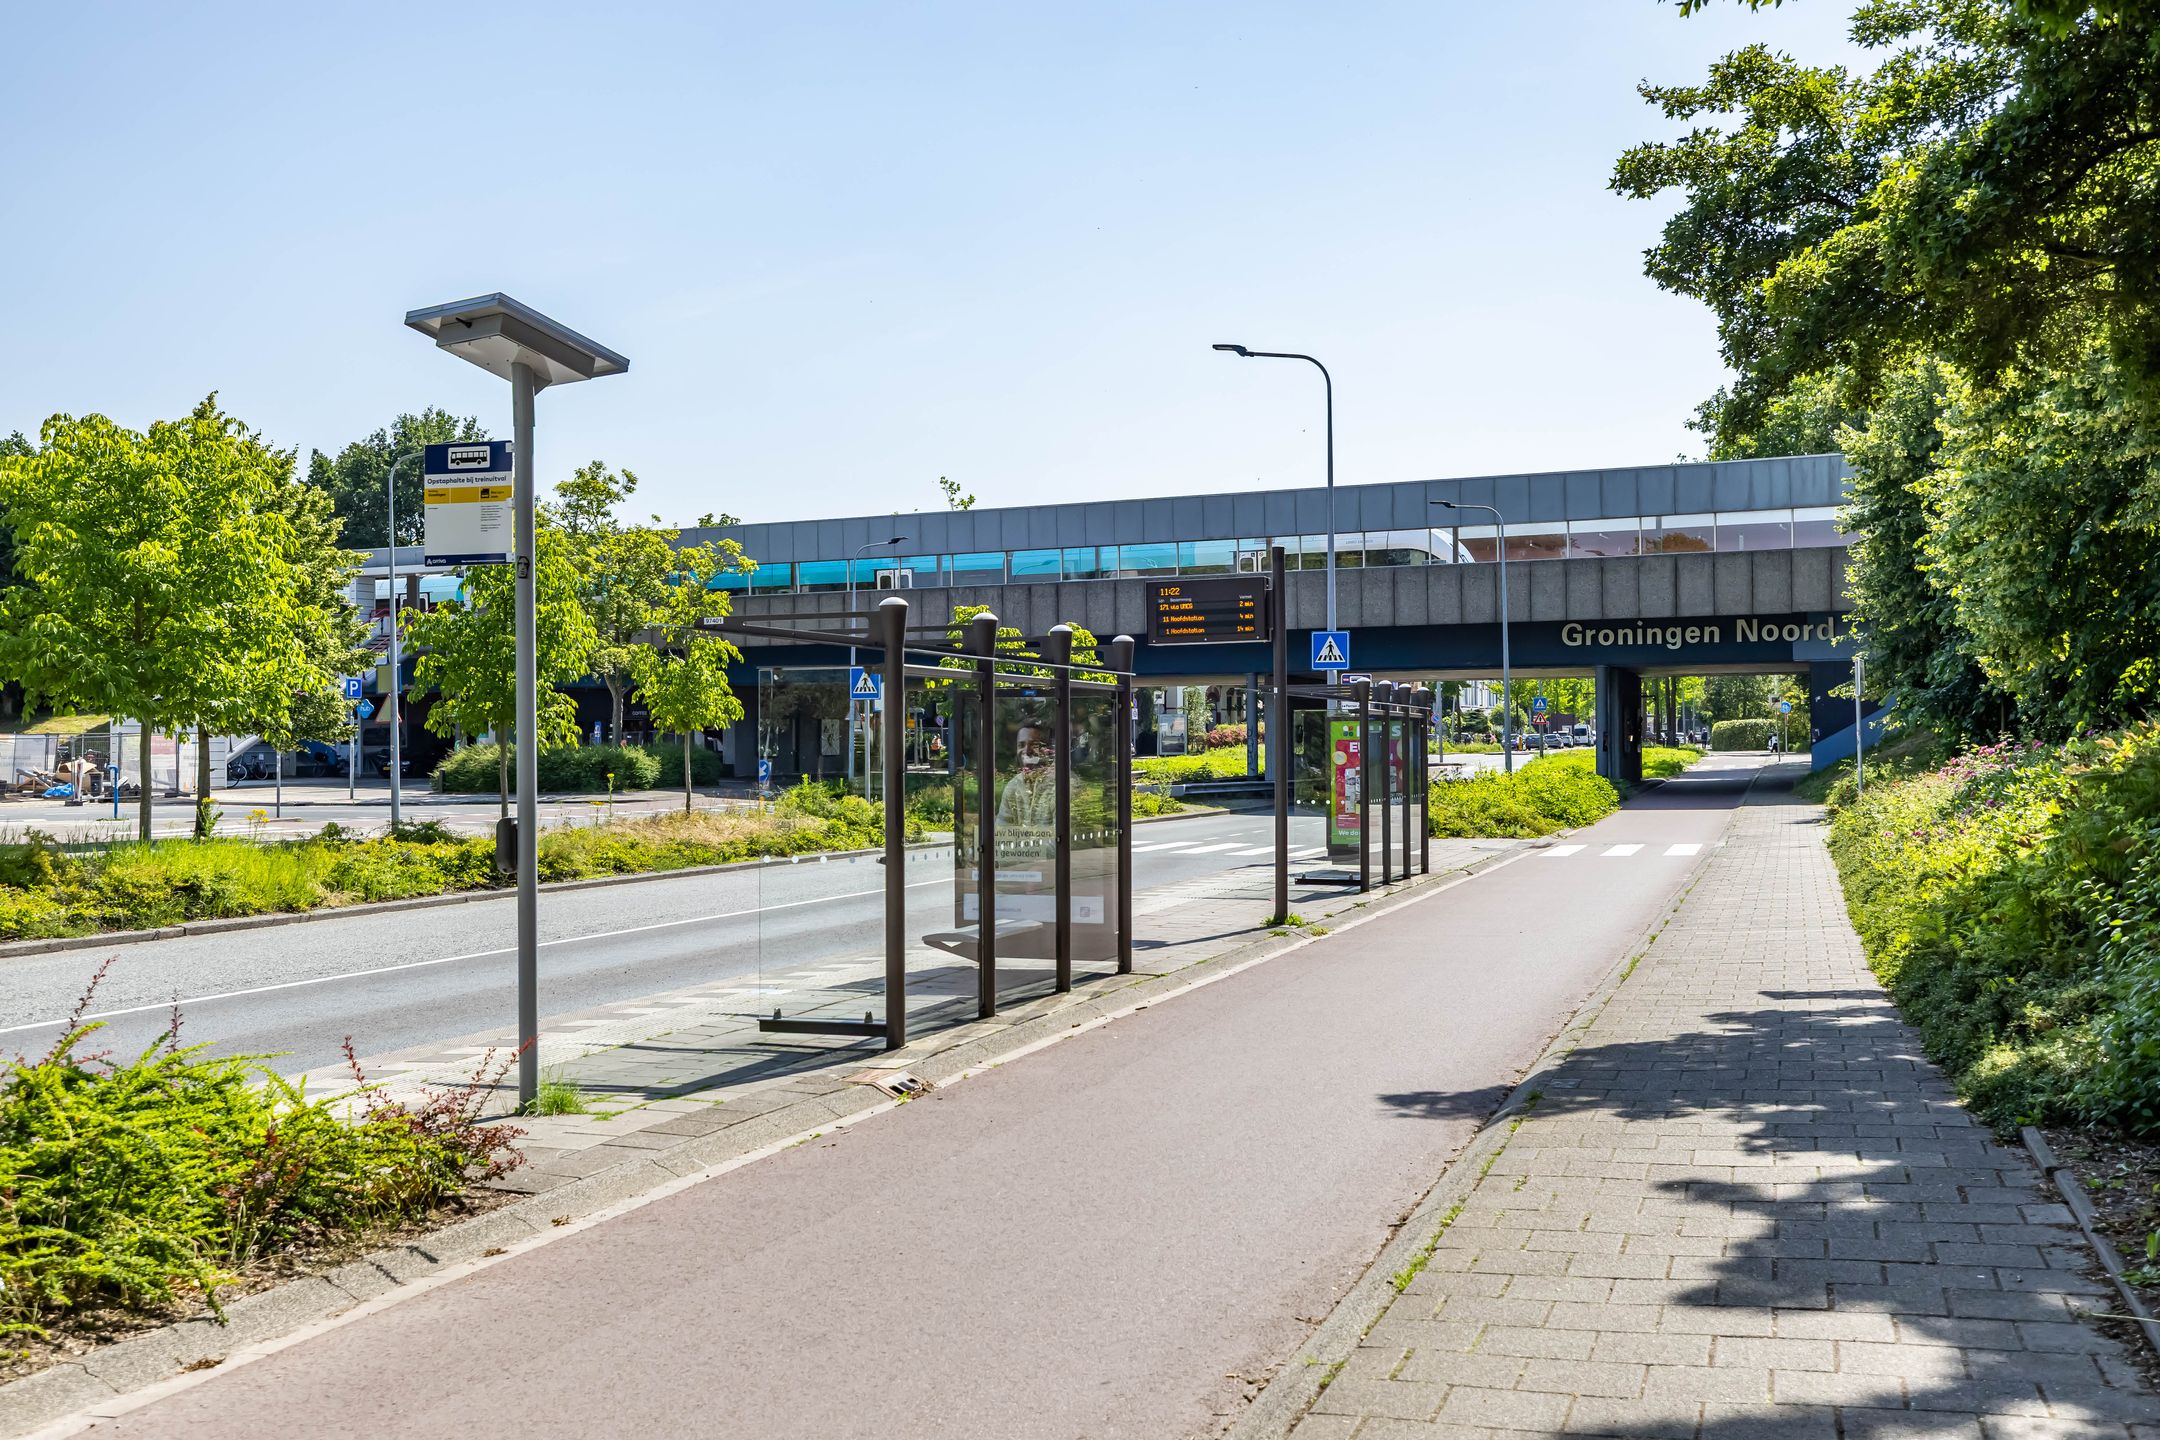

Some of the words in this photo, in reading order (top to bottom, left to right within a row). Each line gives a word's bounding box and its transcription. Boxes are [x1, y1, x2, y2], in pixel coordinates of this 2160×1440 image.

[1160, 587, 1180, 596] 11:22
[1561, 620, 1720, 650] Groningen
[1736, 617, 1835, 643] Noord
[350, 681, 358, 695] P
[1007, 829, 1034, 838] blijven
